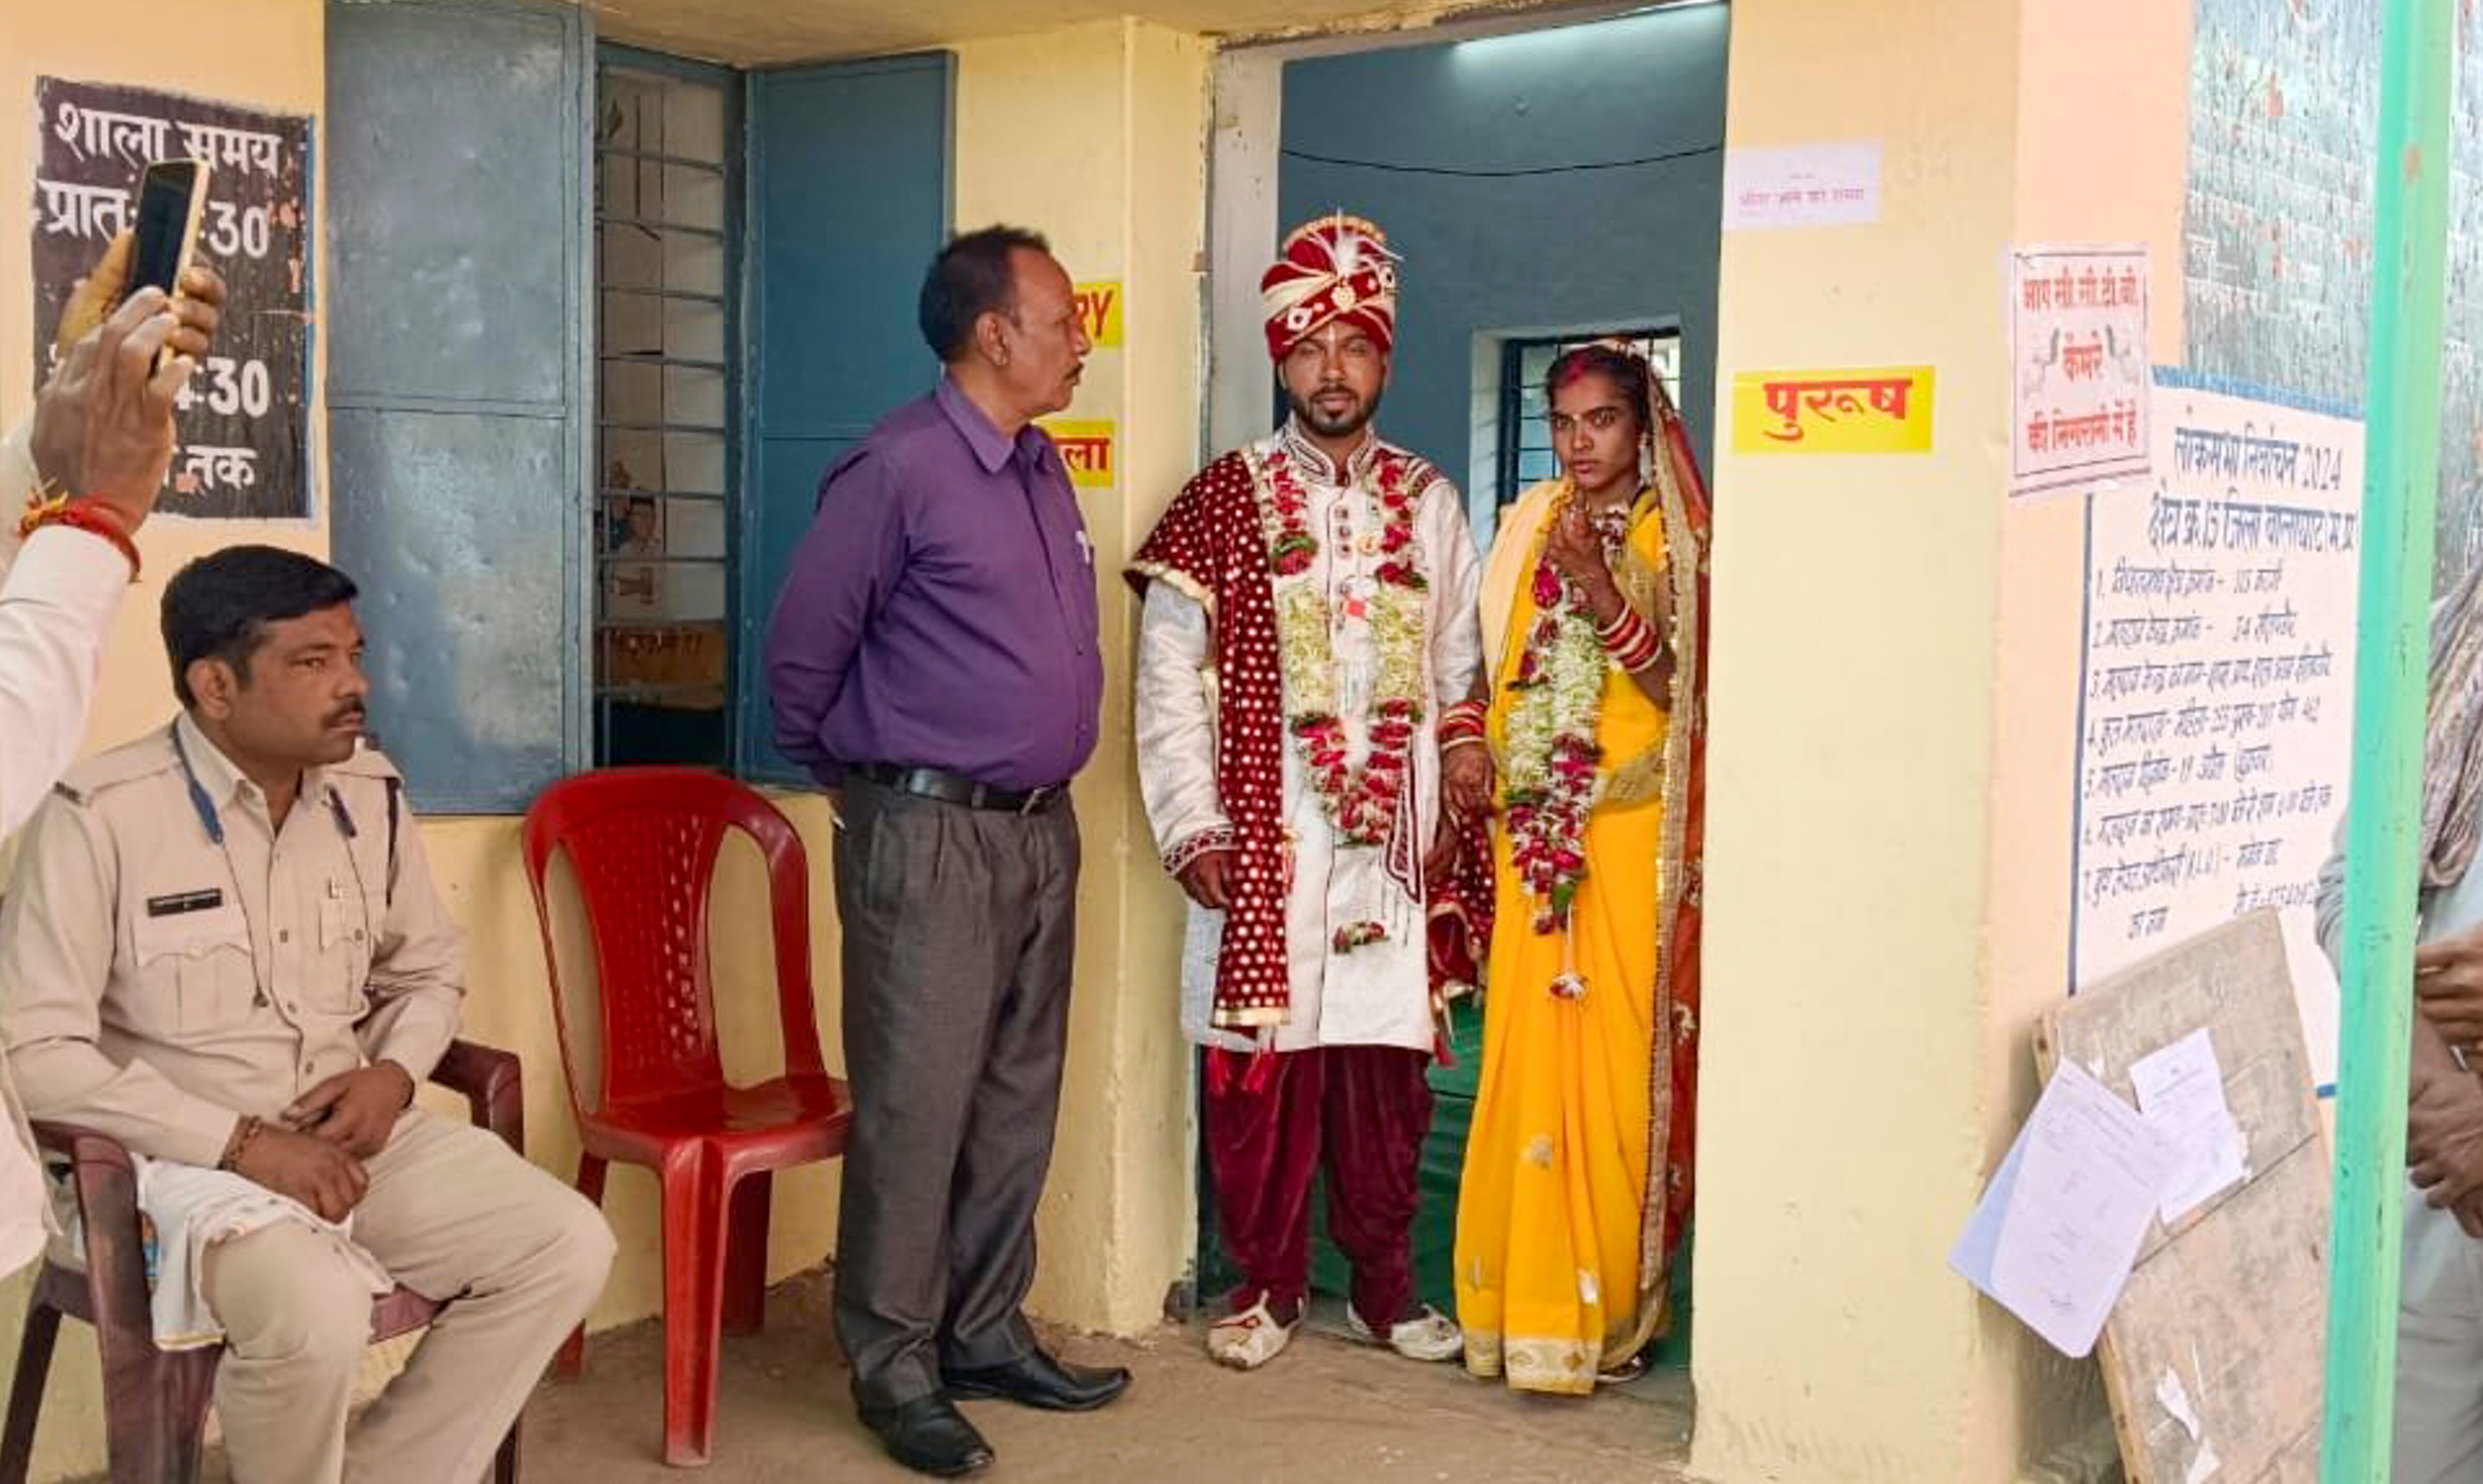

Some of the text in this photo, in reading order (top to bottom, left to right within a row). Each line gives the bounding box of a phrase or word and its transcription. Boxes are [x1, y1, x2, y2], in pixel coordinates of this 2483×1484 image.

[55, 103, 284, 178] शाला समय
[2302, 446, 2343, 490] 2024
